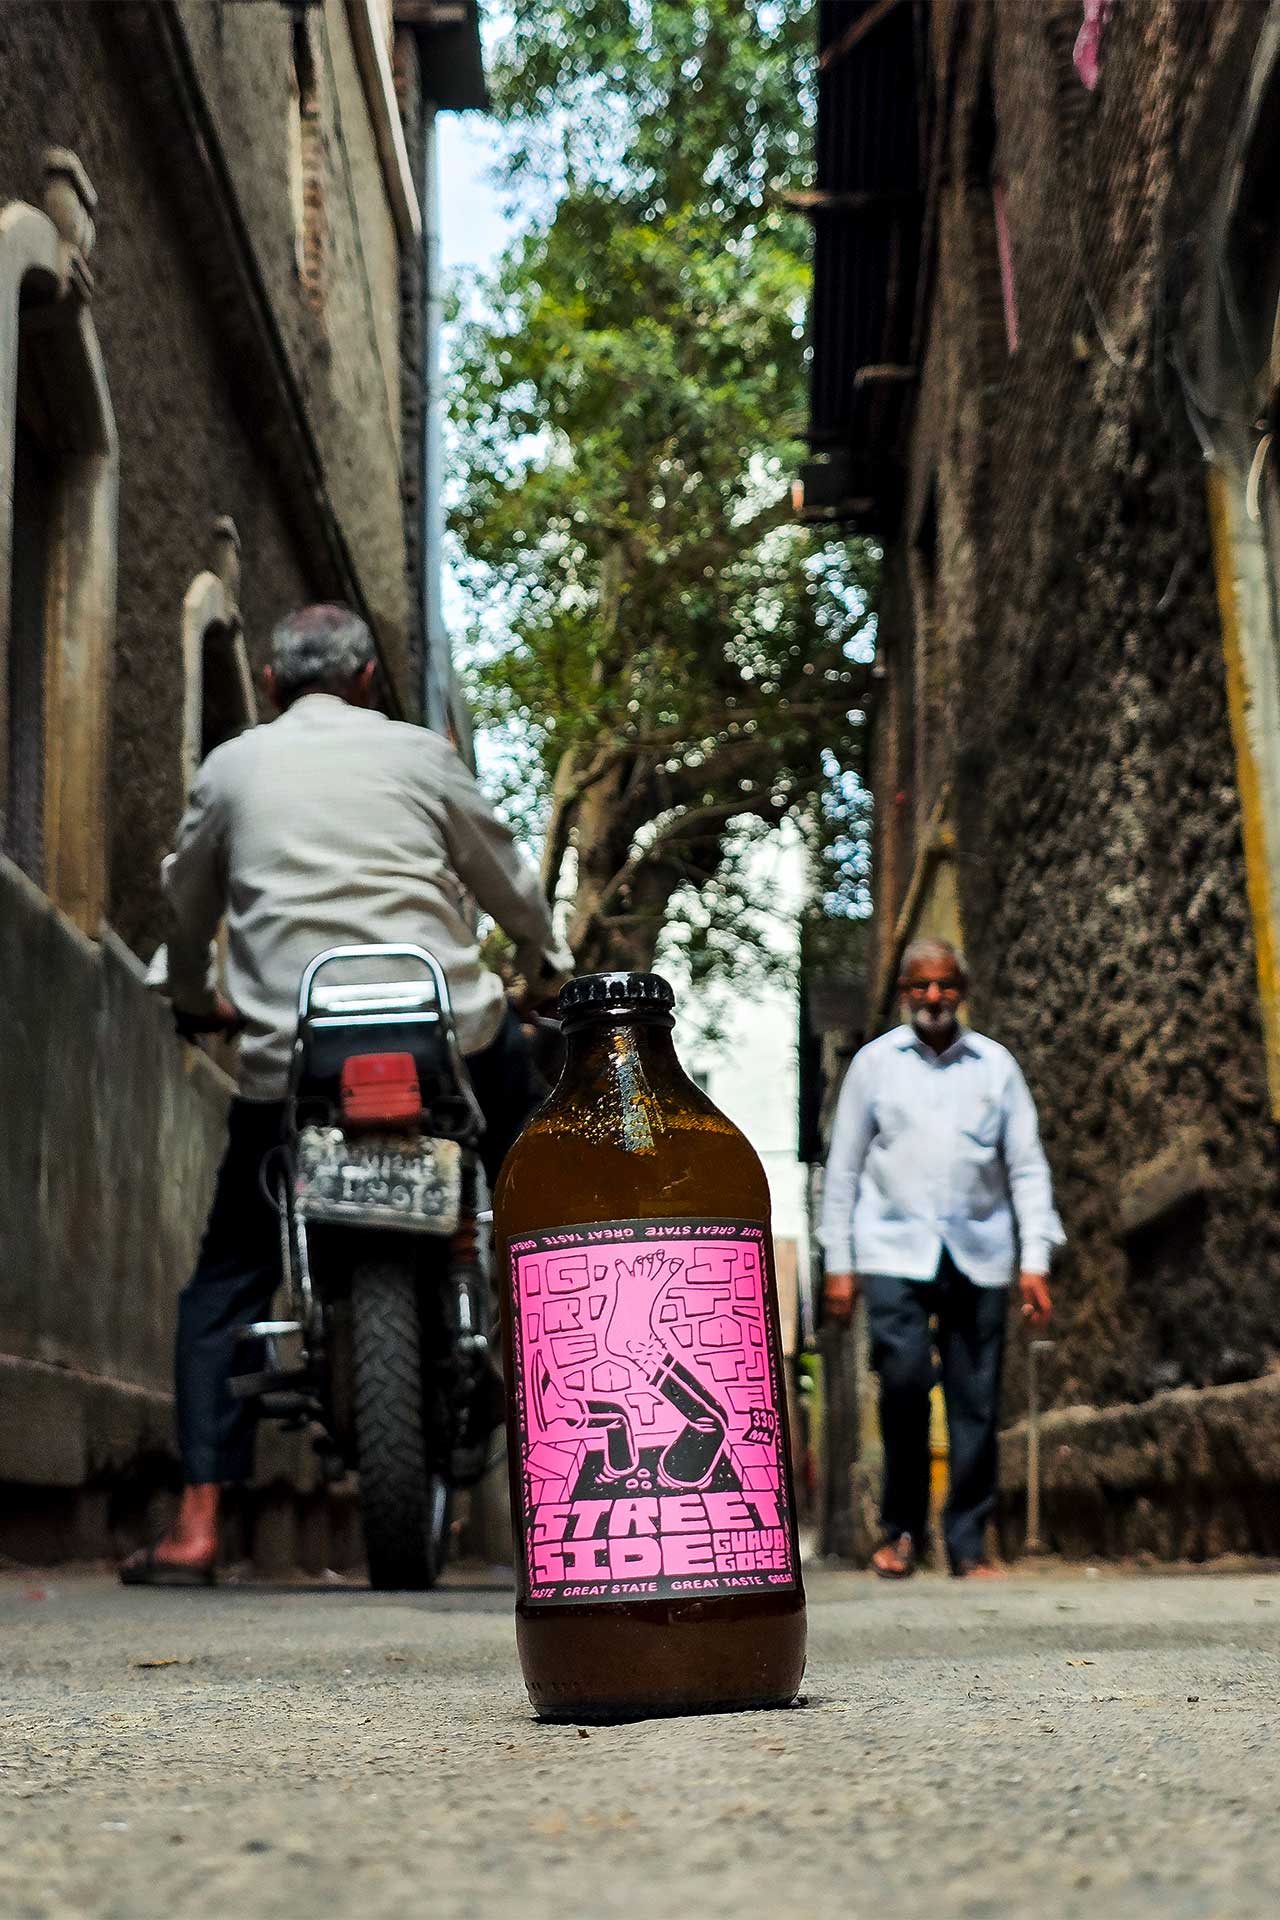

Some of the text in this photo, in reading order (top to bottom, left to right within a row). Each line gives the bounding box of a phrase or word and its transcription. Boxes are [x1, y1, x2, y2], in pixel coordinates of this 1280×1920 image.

[542, 1232, 584, 1245] TASTE
[588, 1228, 634, 1240] GREAT
[694, 1226, 736, 1236] GREAT
[510, 1239, 537, 1253] GREAT
[752, 1410, 774, 1430] 330
[749, 1429, 771, 1442] ML
[533, 1491, 781, 1543] STREET
[713, 1528, 786, 1554] GUAVA
[533, 1533, 715, 1583] SIDE
[715, 1550, 787, 1572] GOSE
[563, 1585, 607, 1597] GREAT
[611, 1582, 658, 1594] STATE
[671, 1579, 719, 1591] GREAT
[722, 1576, 764, 1587] TASTE
